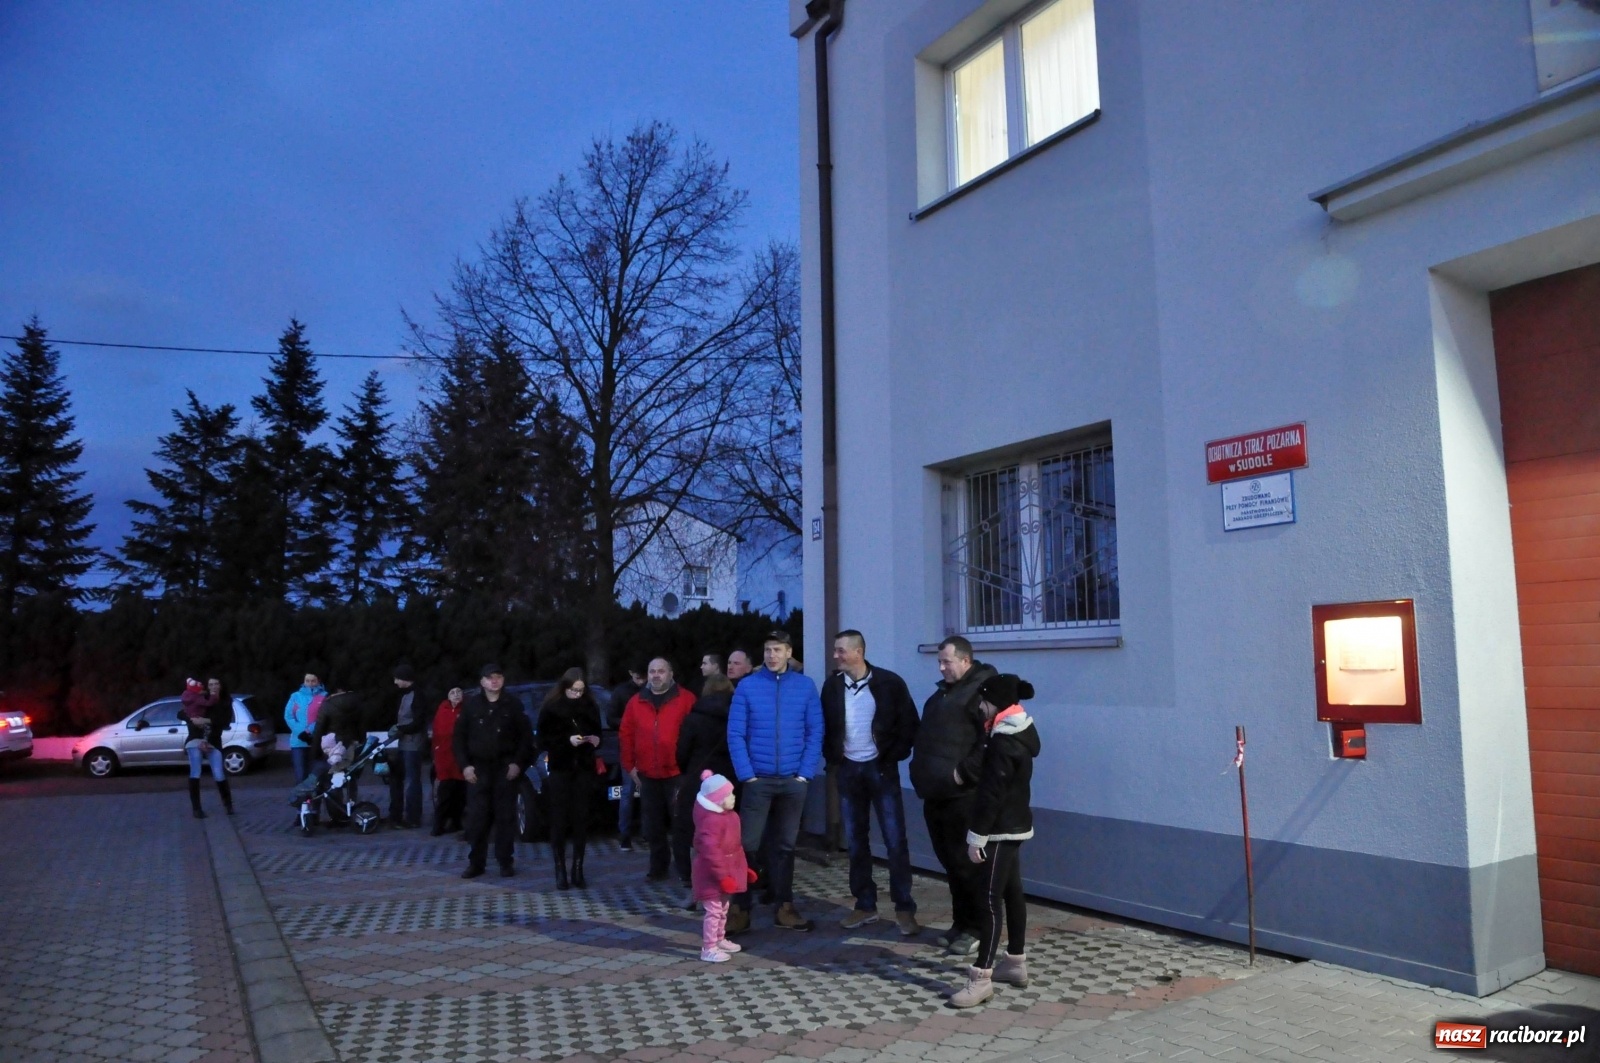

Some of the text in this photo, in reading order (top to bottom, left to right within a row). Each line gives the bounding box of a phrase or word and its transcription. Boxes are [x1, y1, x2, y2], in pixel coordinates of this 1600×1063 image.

[1208, 441, 1242, 463] OCHOTNICZA
[1267, 429, 1301, 450] POŻARNA
[1237, 454, 1273, 472] SUDOLE
[1238, 501, 1258, 509] POMOCY
